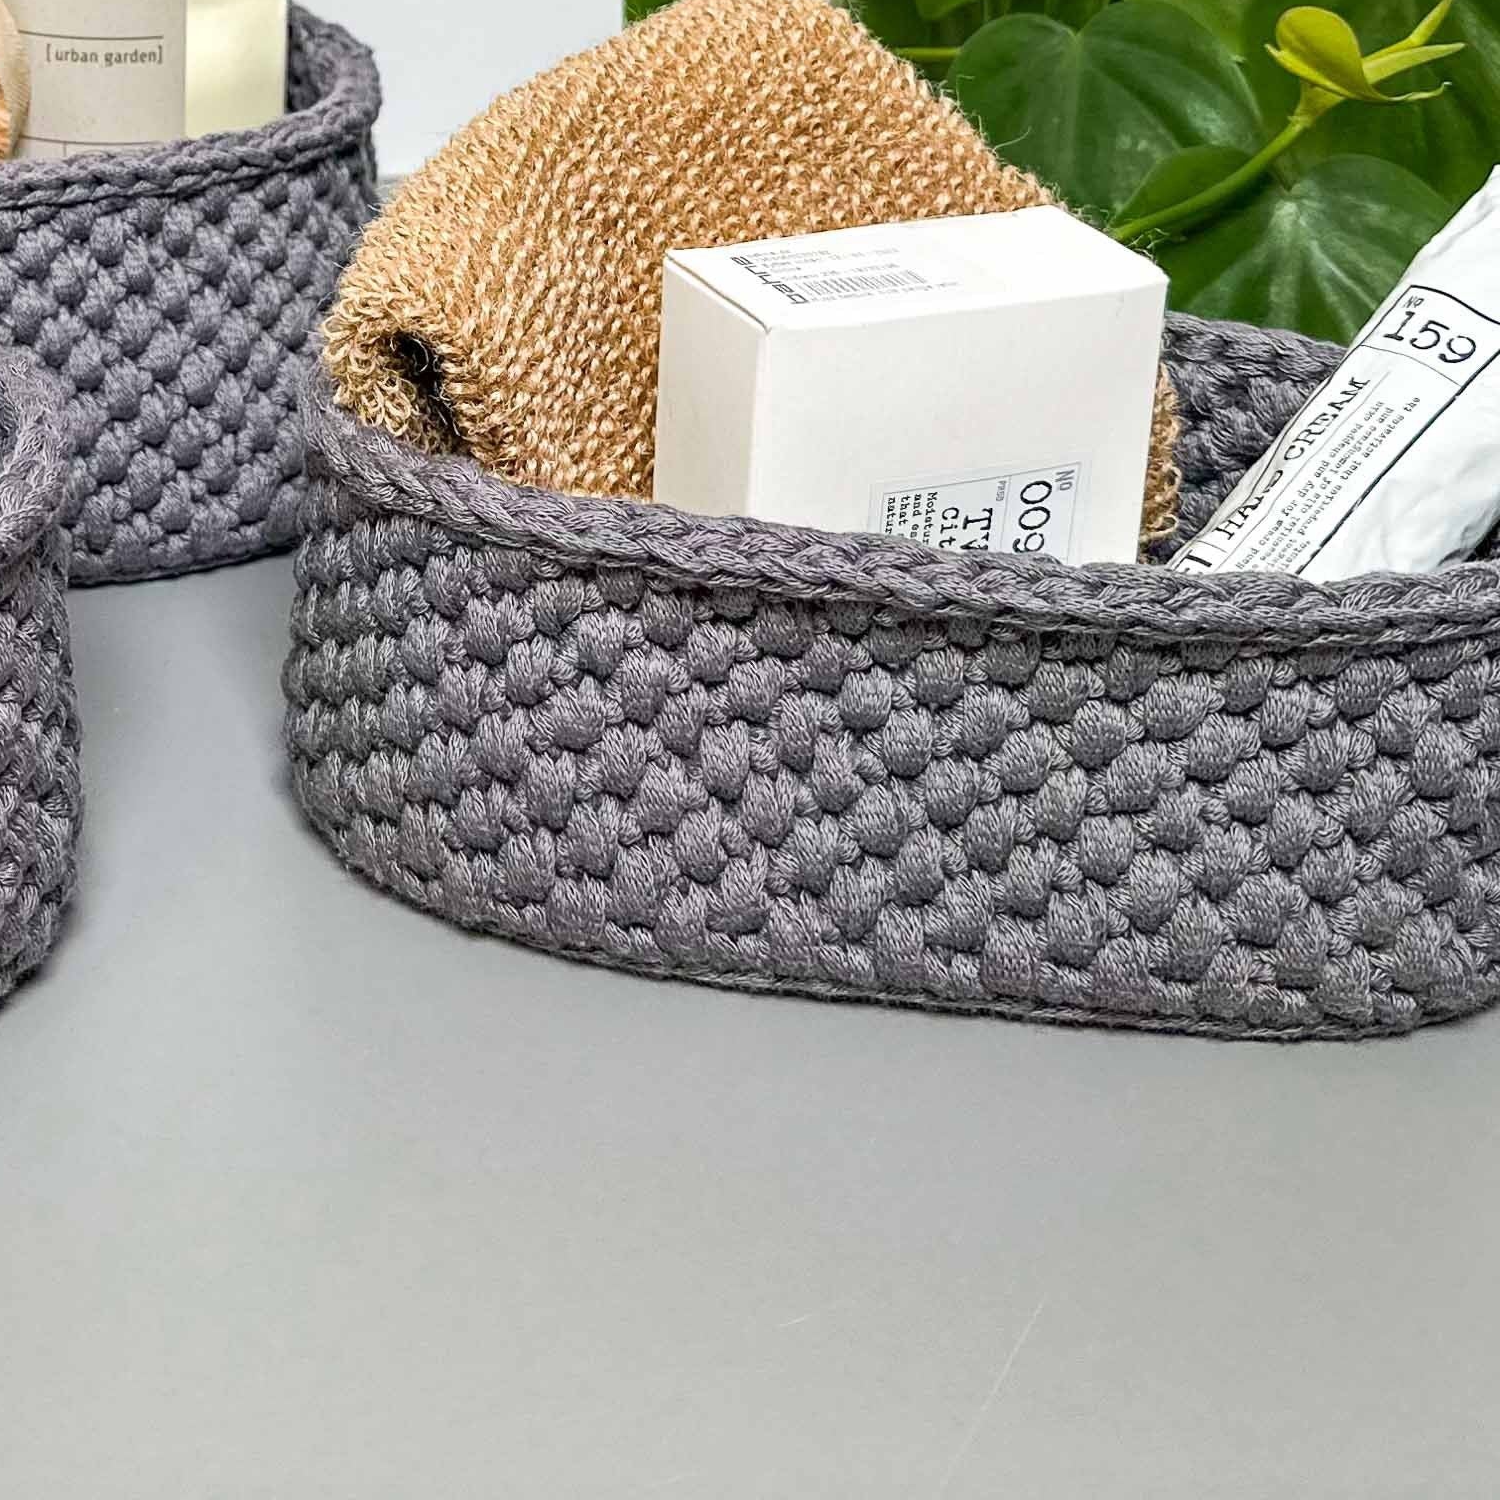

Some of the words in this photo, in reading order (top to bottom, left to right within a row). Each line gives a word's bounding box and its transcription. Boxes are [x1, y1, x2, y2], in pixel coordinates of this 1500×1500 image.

[1383, 311, 1476, 363] 159
[1285, 376, 1371, 462] CREAM
[1339, 460, 1362, 481] that
[1403, 397, 1421, 413] the
[899, 495, 911, 526] that
[912, 494, 922, 518] and
[1280, 499, 1298, 517] for
[1297, 480, 1315, 498] dry
[1313, 459, 1331, 478] and
